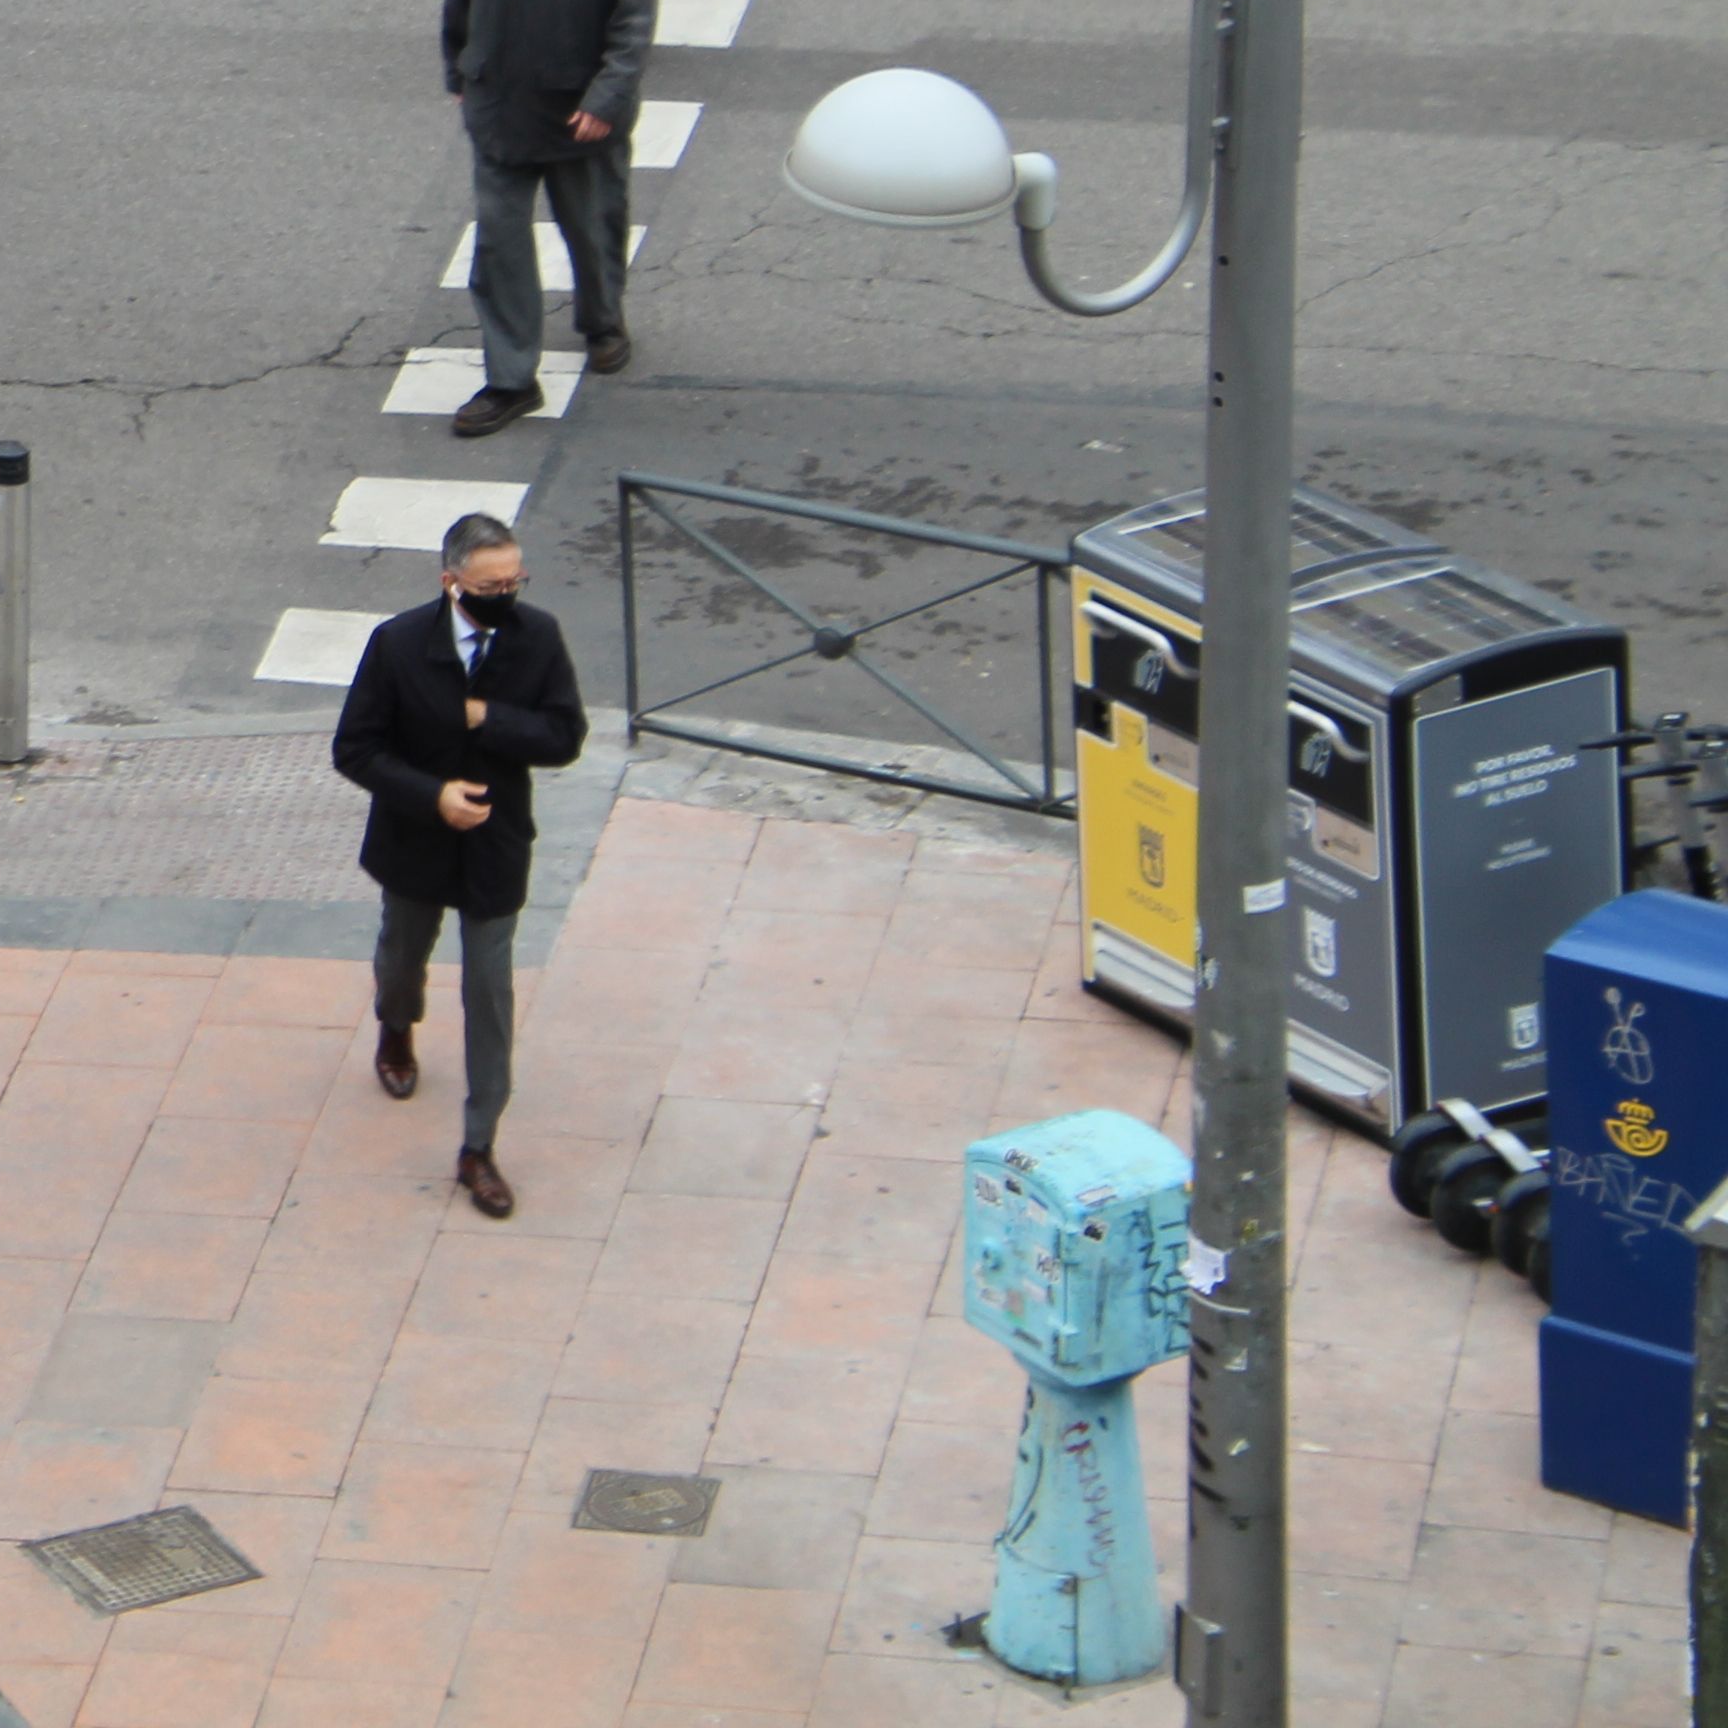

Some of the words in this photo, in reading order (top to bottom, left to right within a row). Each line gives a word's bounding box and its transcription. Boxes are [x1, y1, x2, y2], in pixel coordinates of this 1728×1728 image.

[1454, 780, 1479, 798] NO
[1479, 772, 1509, 791] TIRE
[1509, 754, 1578, 782] RESIDUOS
[1475, 756, 1506, 773] POR
[1484, 791, 1505, 807] AL
[1504, 779, 1548, 800] SUELO
